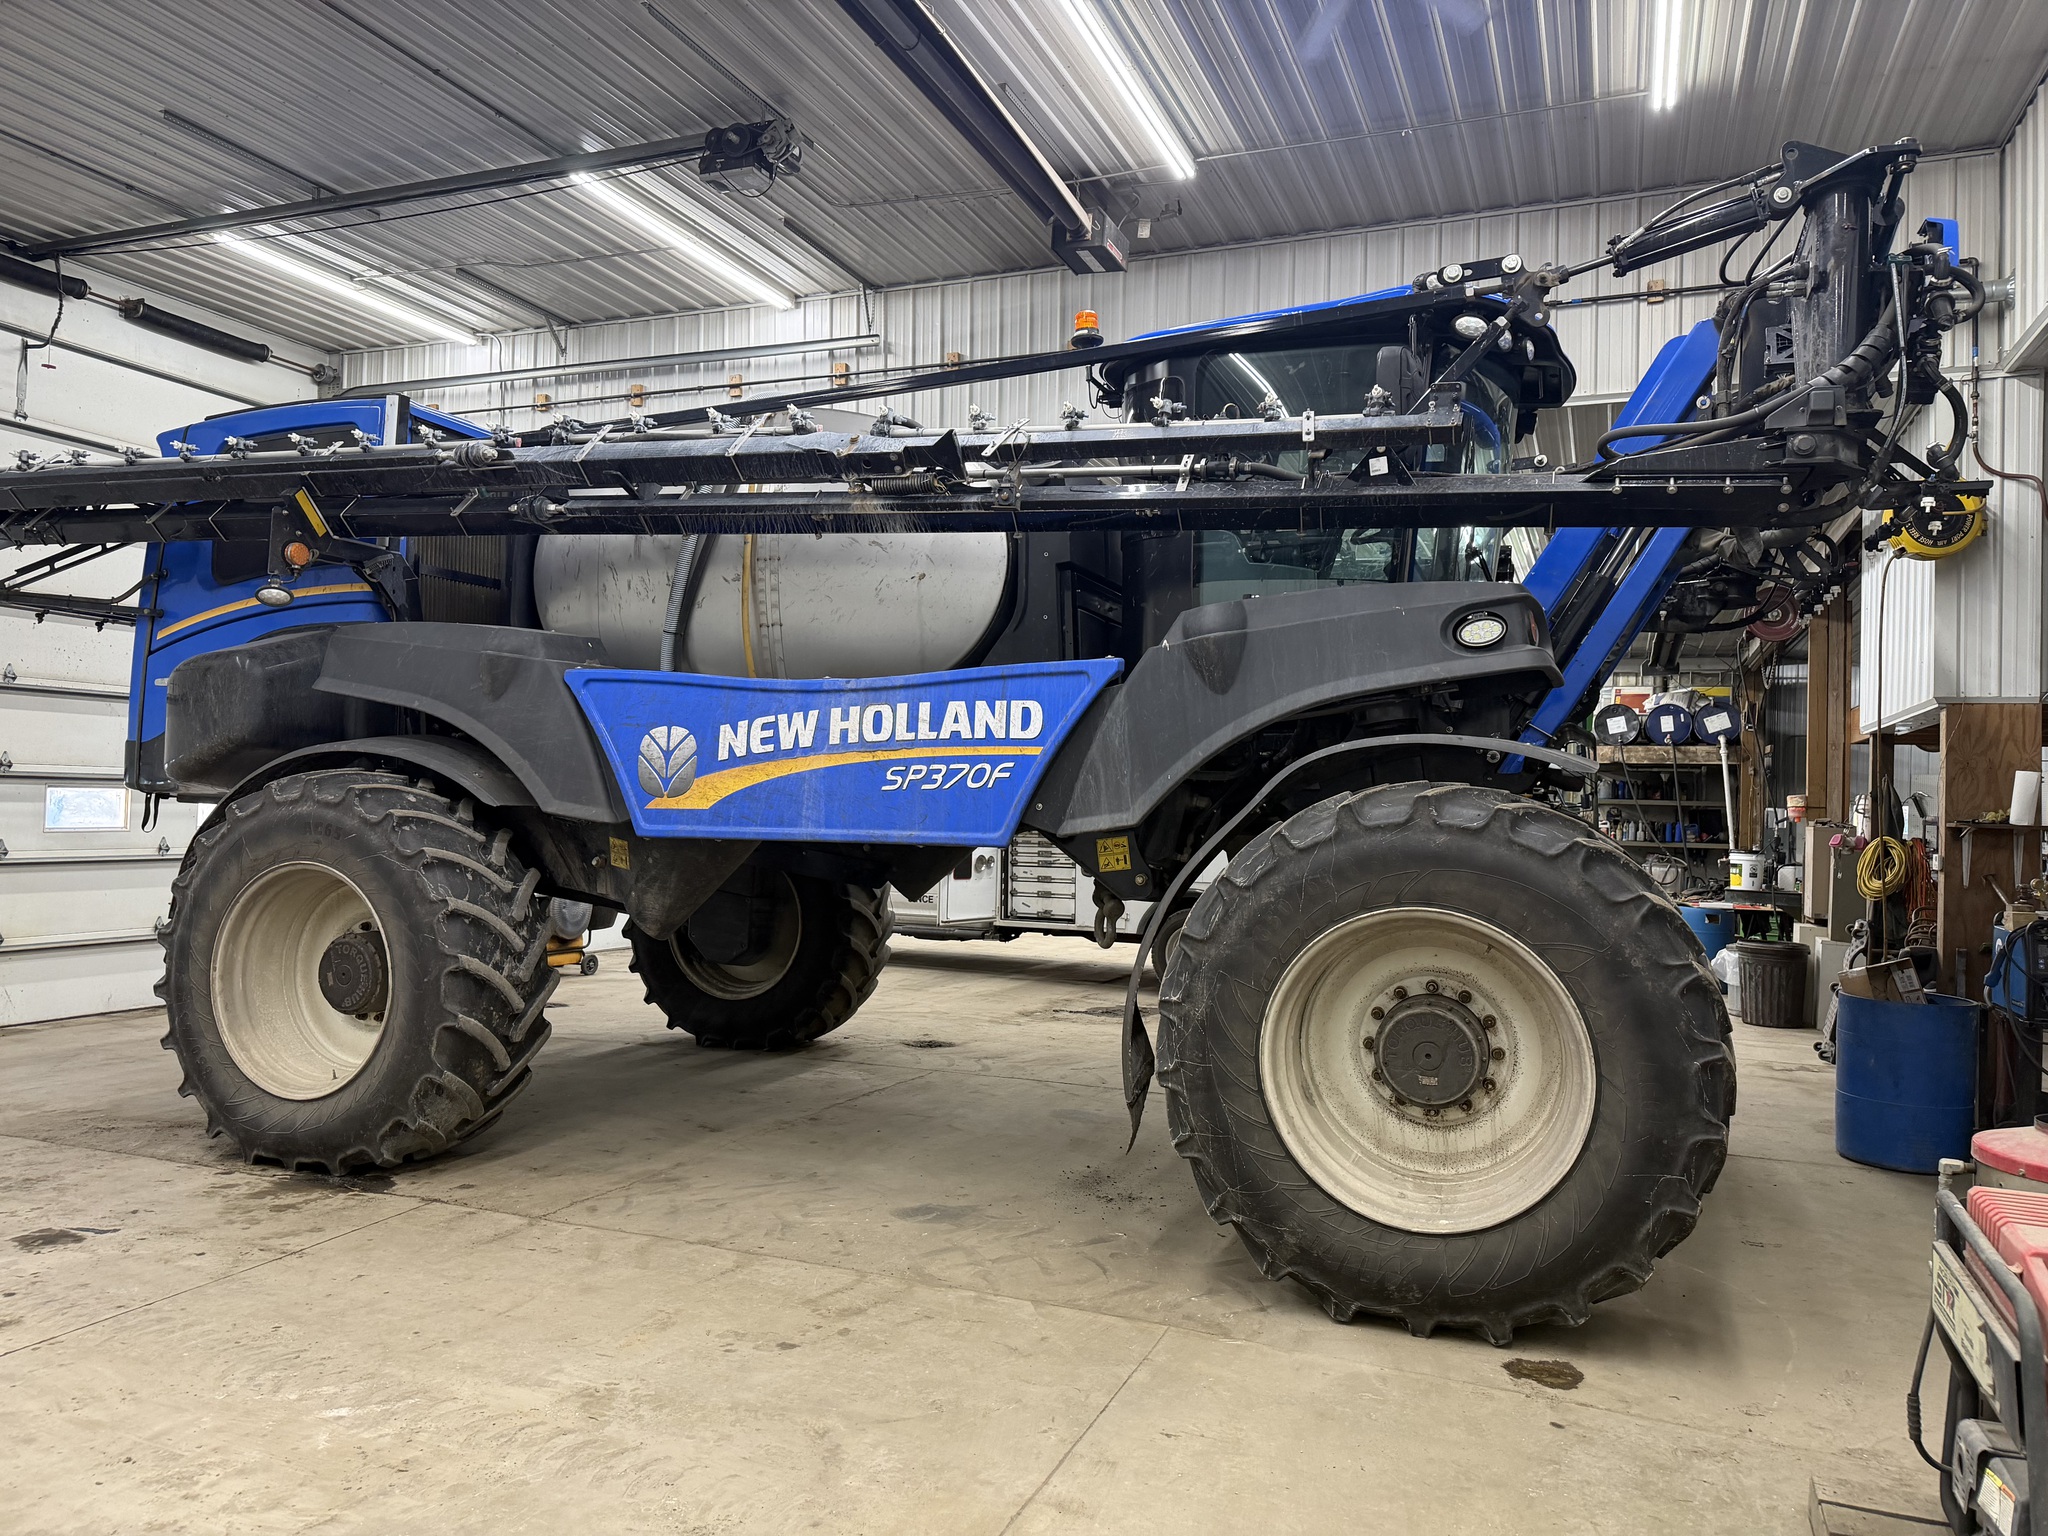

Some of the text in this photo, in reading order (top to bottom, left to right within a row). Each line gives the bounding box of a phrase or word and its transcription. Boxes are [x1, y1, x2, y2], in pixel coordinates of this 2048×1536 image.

[718, 700, 1044, 761] NEW HOLLAND
[881, 762, 1015, 791] SP370F
